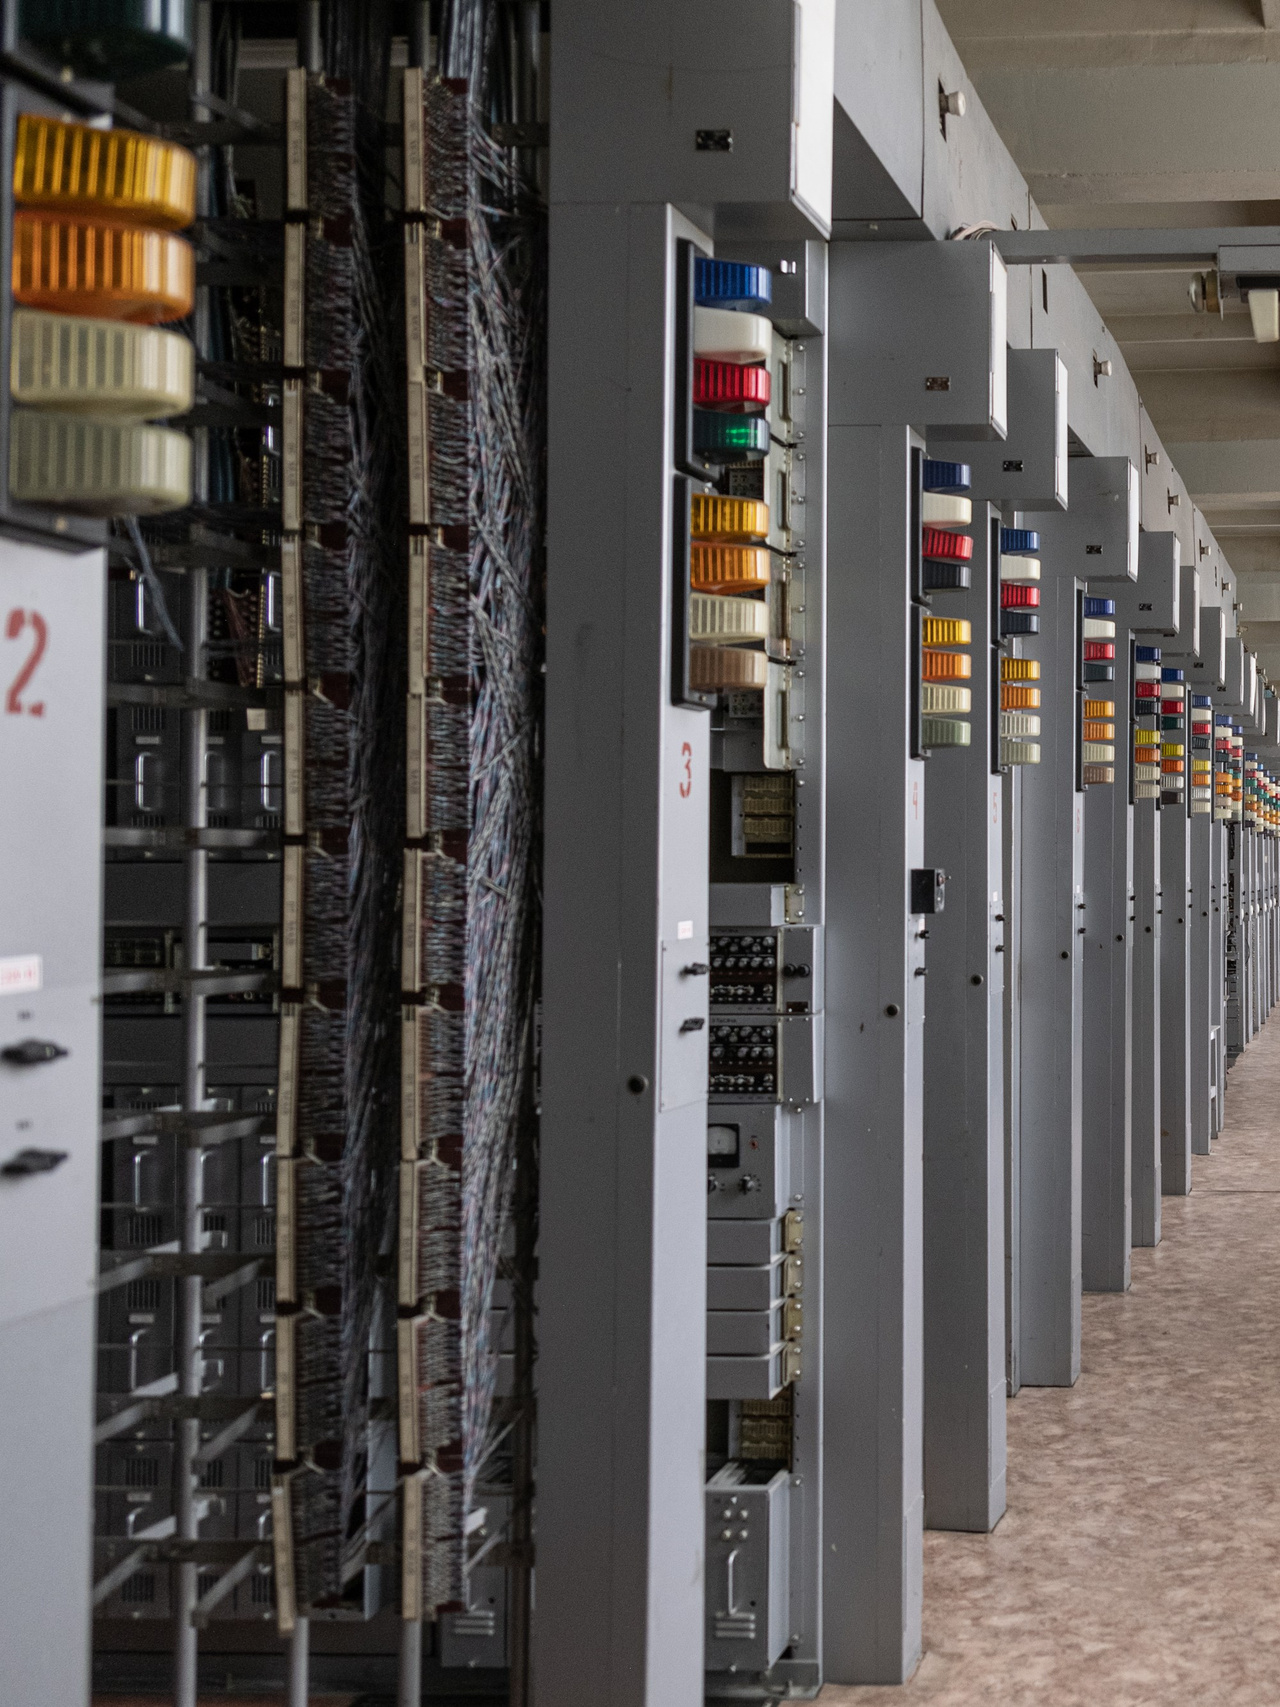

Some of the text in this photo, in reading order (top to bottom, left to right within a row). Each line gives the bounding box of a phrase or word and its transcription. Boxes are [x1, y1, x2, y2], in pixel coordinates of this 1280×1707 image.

[6, 606, 47, 718] 2
[679, 741, 692, 799] 3
[912, 781, 918, 820] 4
[992, 791, 998, 824] 5
